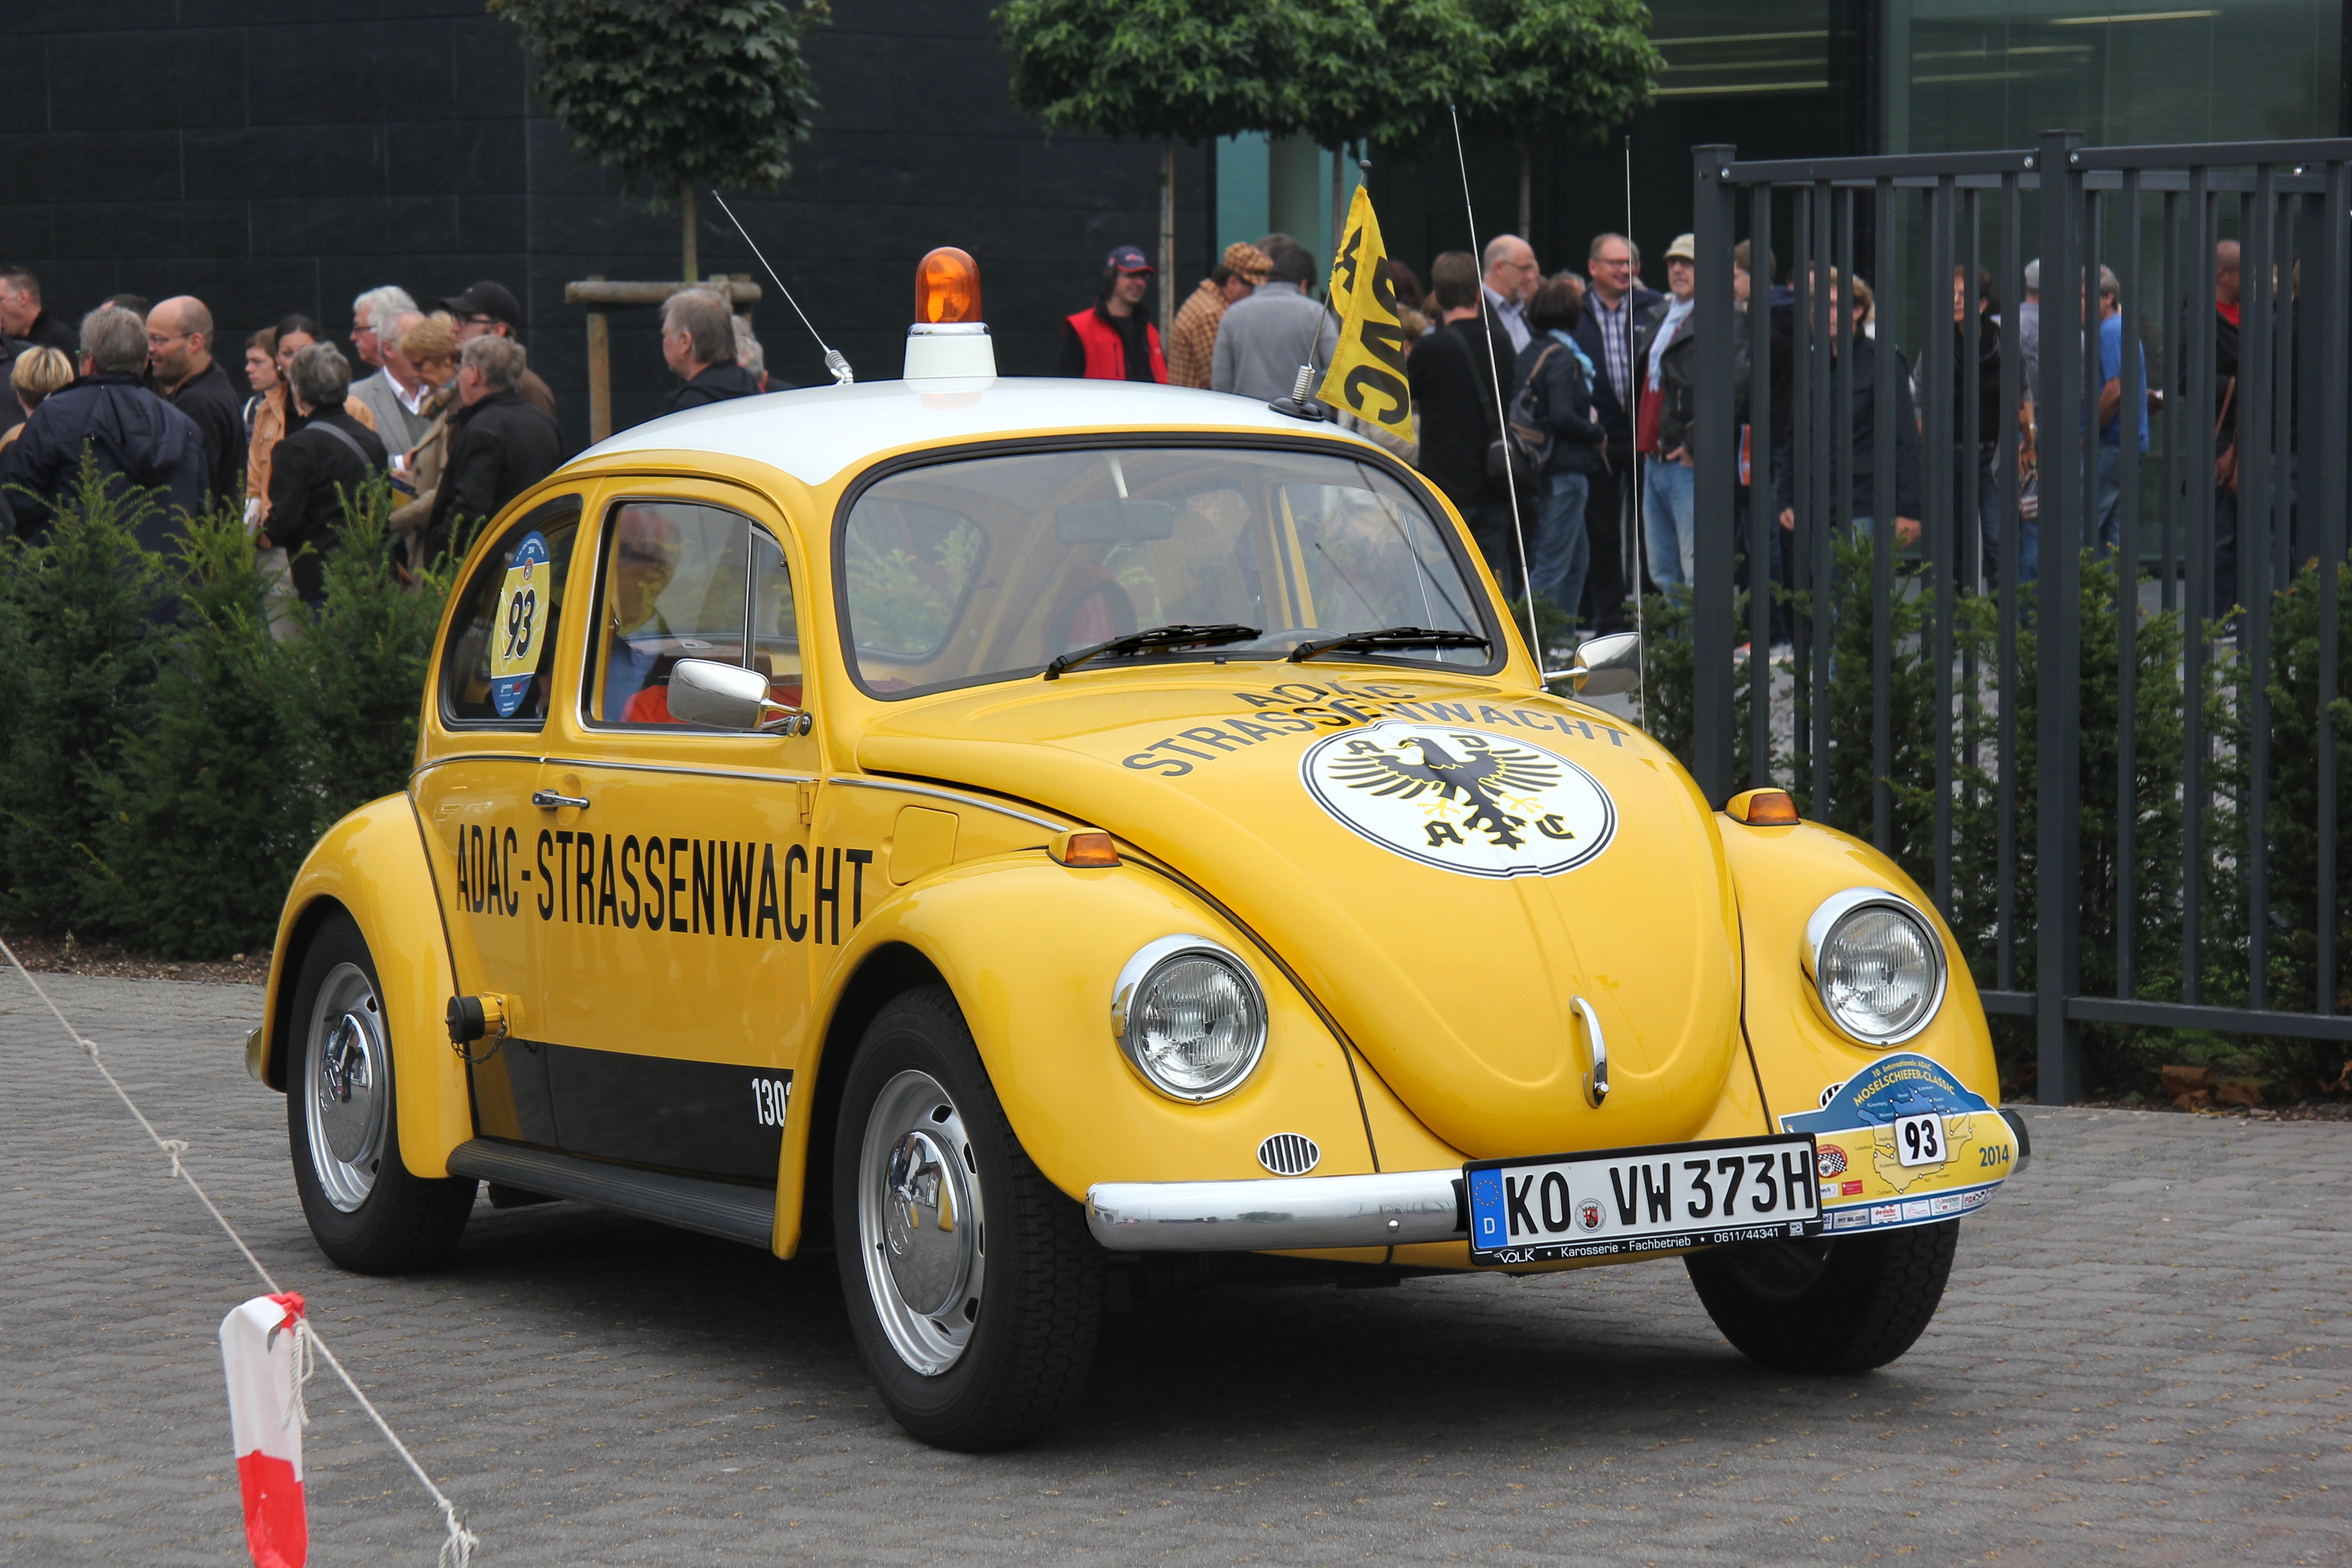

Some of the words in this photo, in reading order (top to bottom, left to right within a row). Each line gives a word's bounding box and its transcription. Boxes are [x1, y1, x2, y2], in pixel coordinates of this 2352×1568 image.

[504, 588, 536, 659] 93
[1121, 698, 1630, 777] STRASSENWACHT
[1853, 1069, 1955, 1107] MOSELSCHIEFER-CLASSIC
[1905, 1120, 1937, 1160] 93
[1979, 1144, 2009, 1167] 2014
[1506, 1171, 1571, 1235] KO
[1610, 1163, 1672, 1225] VW
[1684, 1150, 1814, 1218] 373H
[1483, 1217, 1496, 1234] D
[1498, 1249, 1535, 1263] VOLK
[1561, 1243, 1619, 1258] Karosserie
[1629, 1236, 1691, 1251] Fachbetrieb
